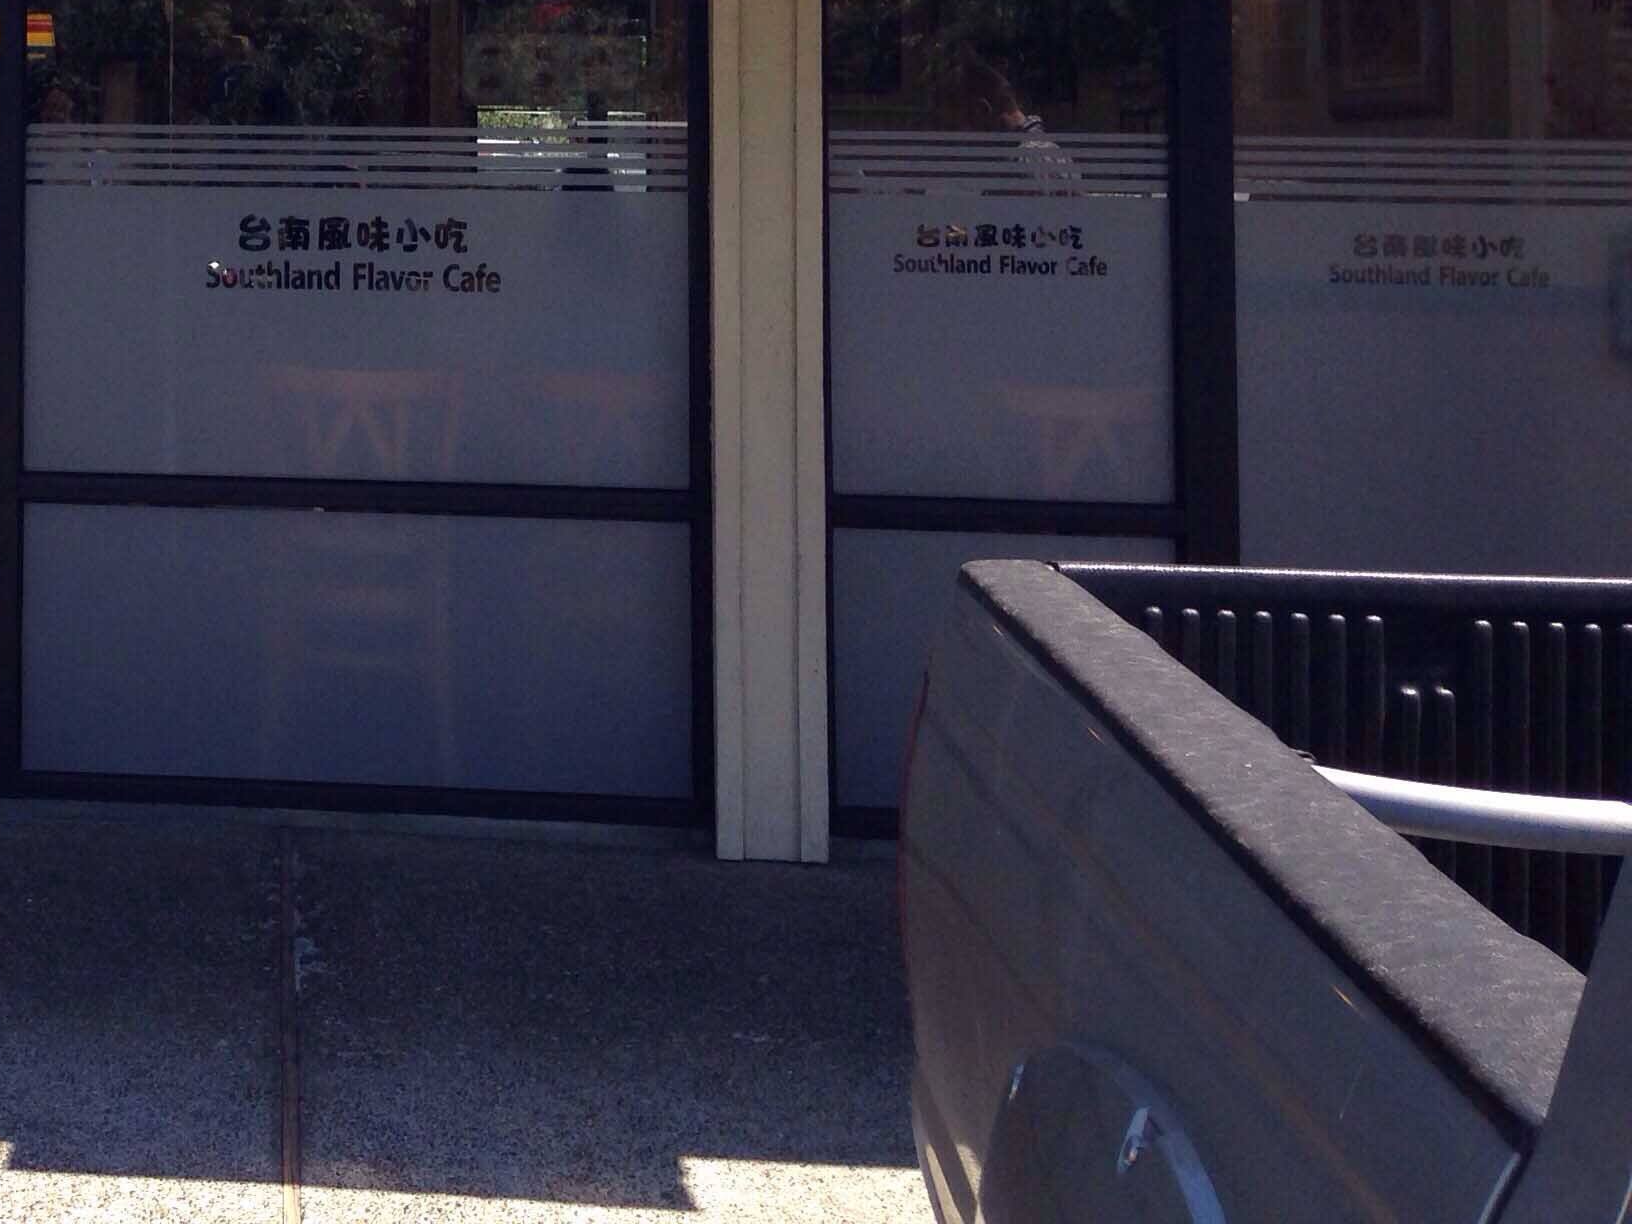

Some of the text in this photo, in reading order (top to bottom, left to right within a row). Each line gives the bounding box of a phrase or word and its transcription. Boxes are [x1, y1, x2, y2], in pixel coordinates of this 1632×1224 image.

[238, 213, 469, 254] 台南風味小吃
[206, 259, 501, 293] Southland Flavor Cafe
[893, 253, 1108, 277] Southland Flavor Cafe
[1329, 263, 1551, 289] Southland Flavor Cafe
